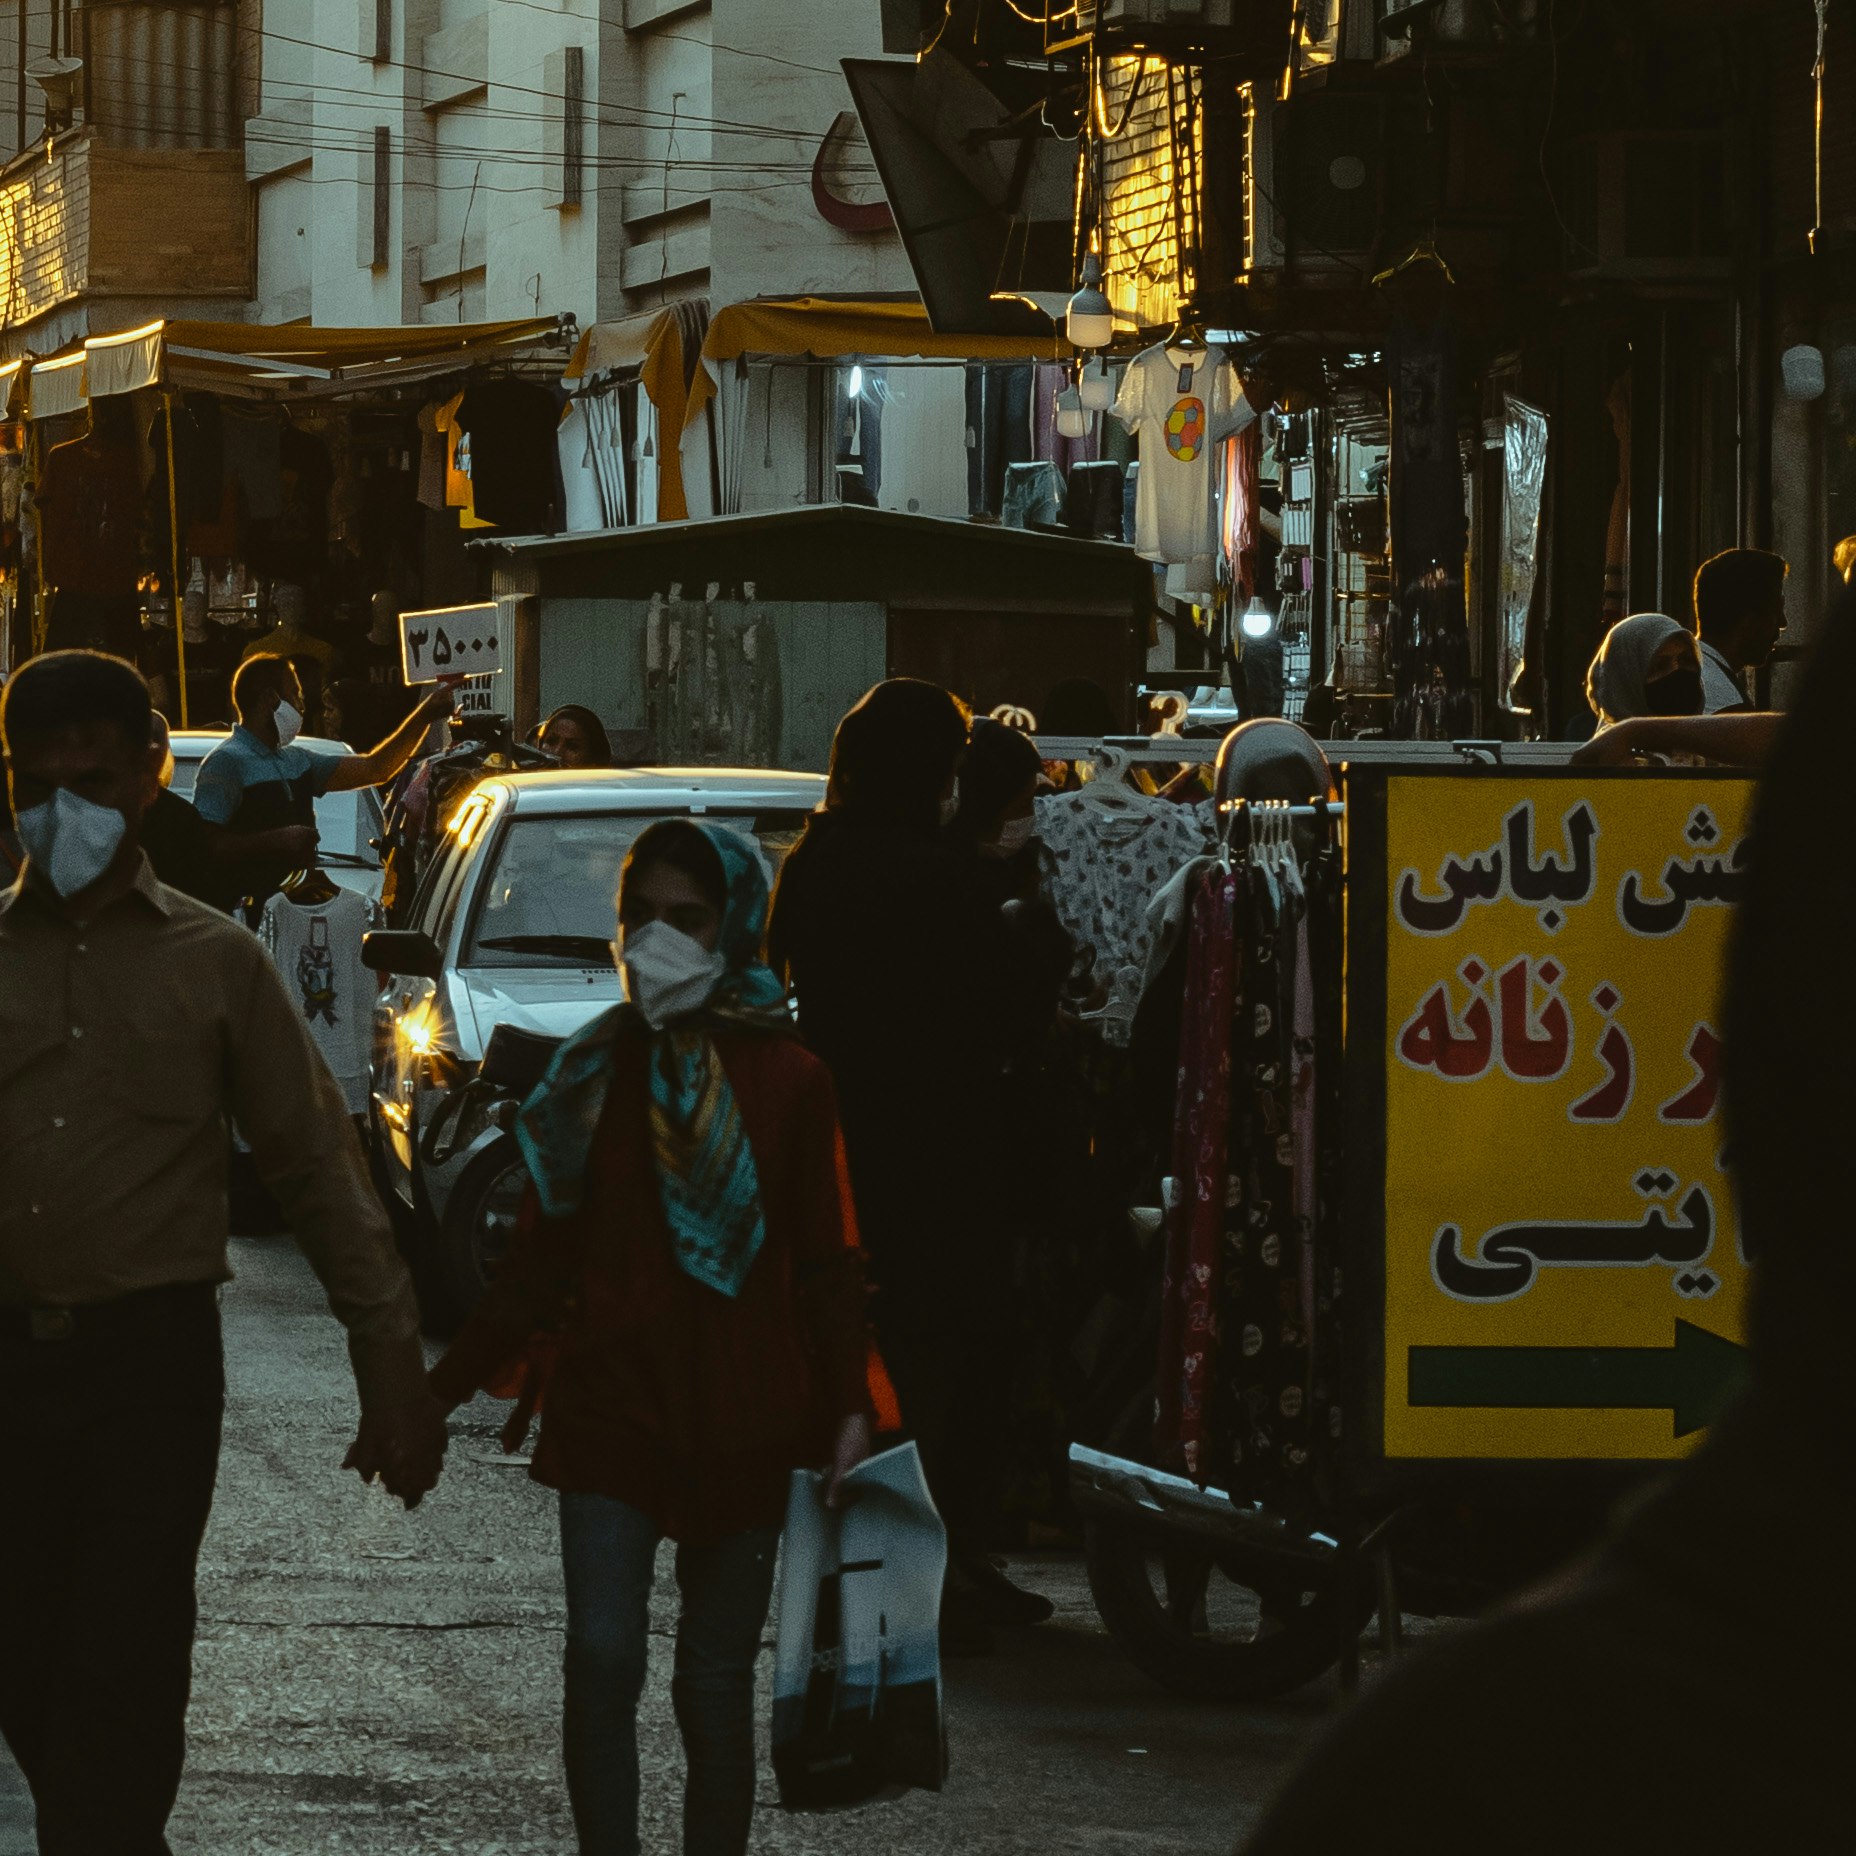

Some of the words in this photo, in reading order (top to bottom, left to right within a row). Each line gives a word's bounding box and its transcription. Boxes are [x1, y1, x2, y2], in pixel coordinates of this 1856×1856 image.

[407, 627, 499, 668] ۳۵۰۰۰
[1398, 800, 1597, 935] لباس
[1400, 958, 1632, 1121] زنانه
